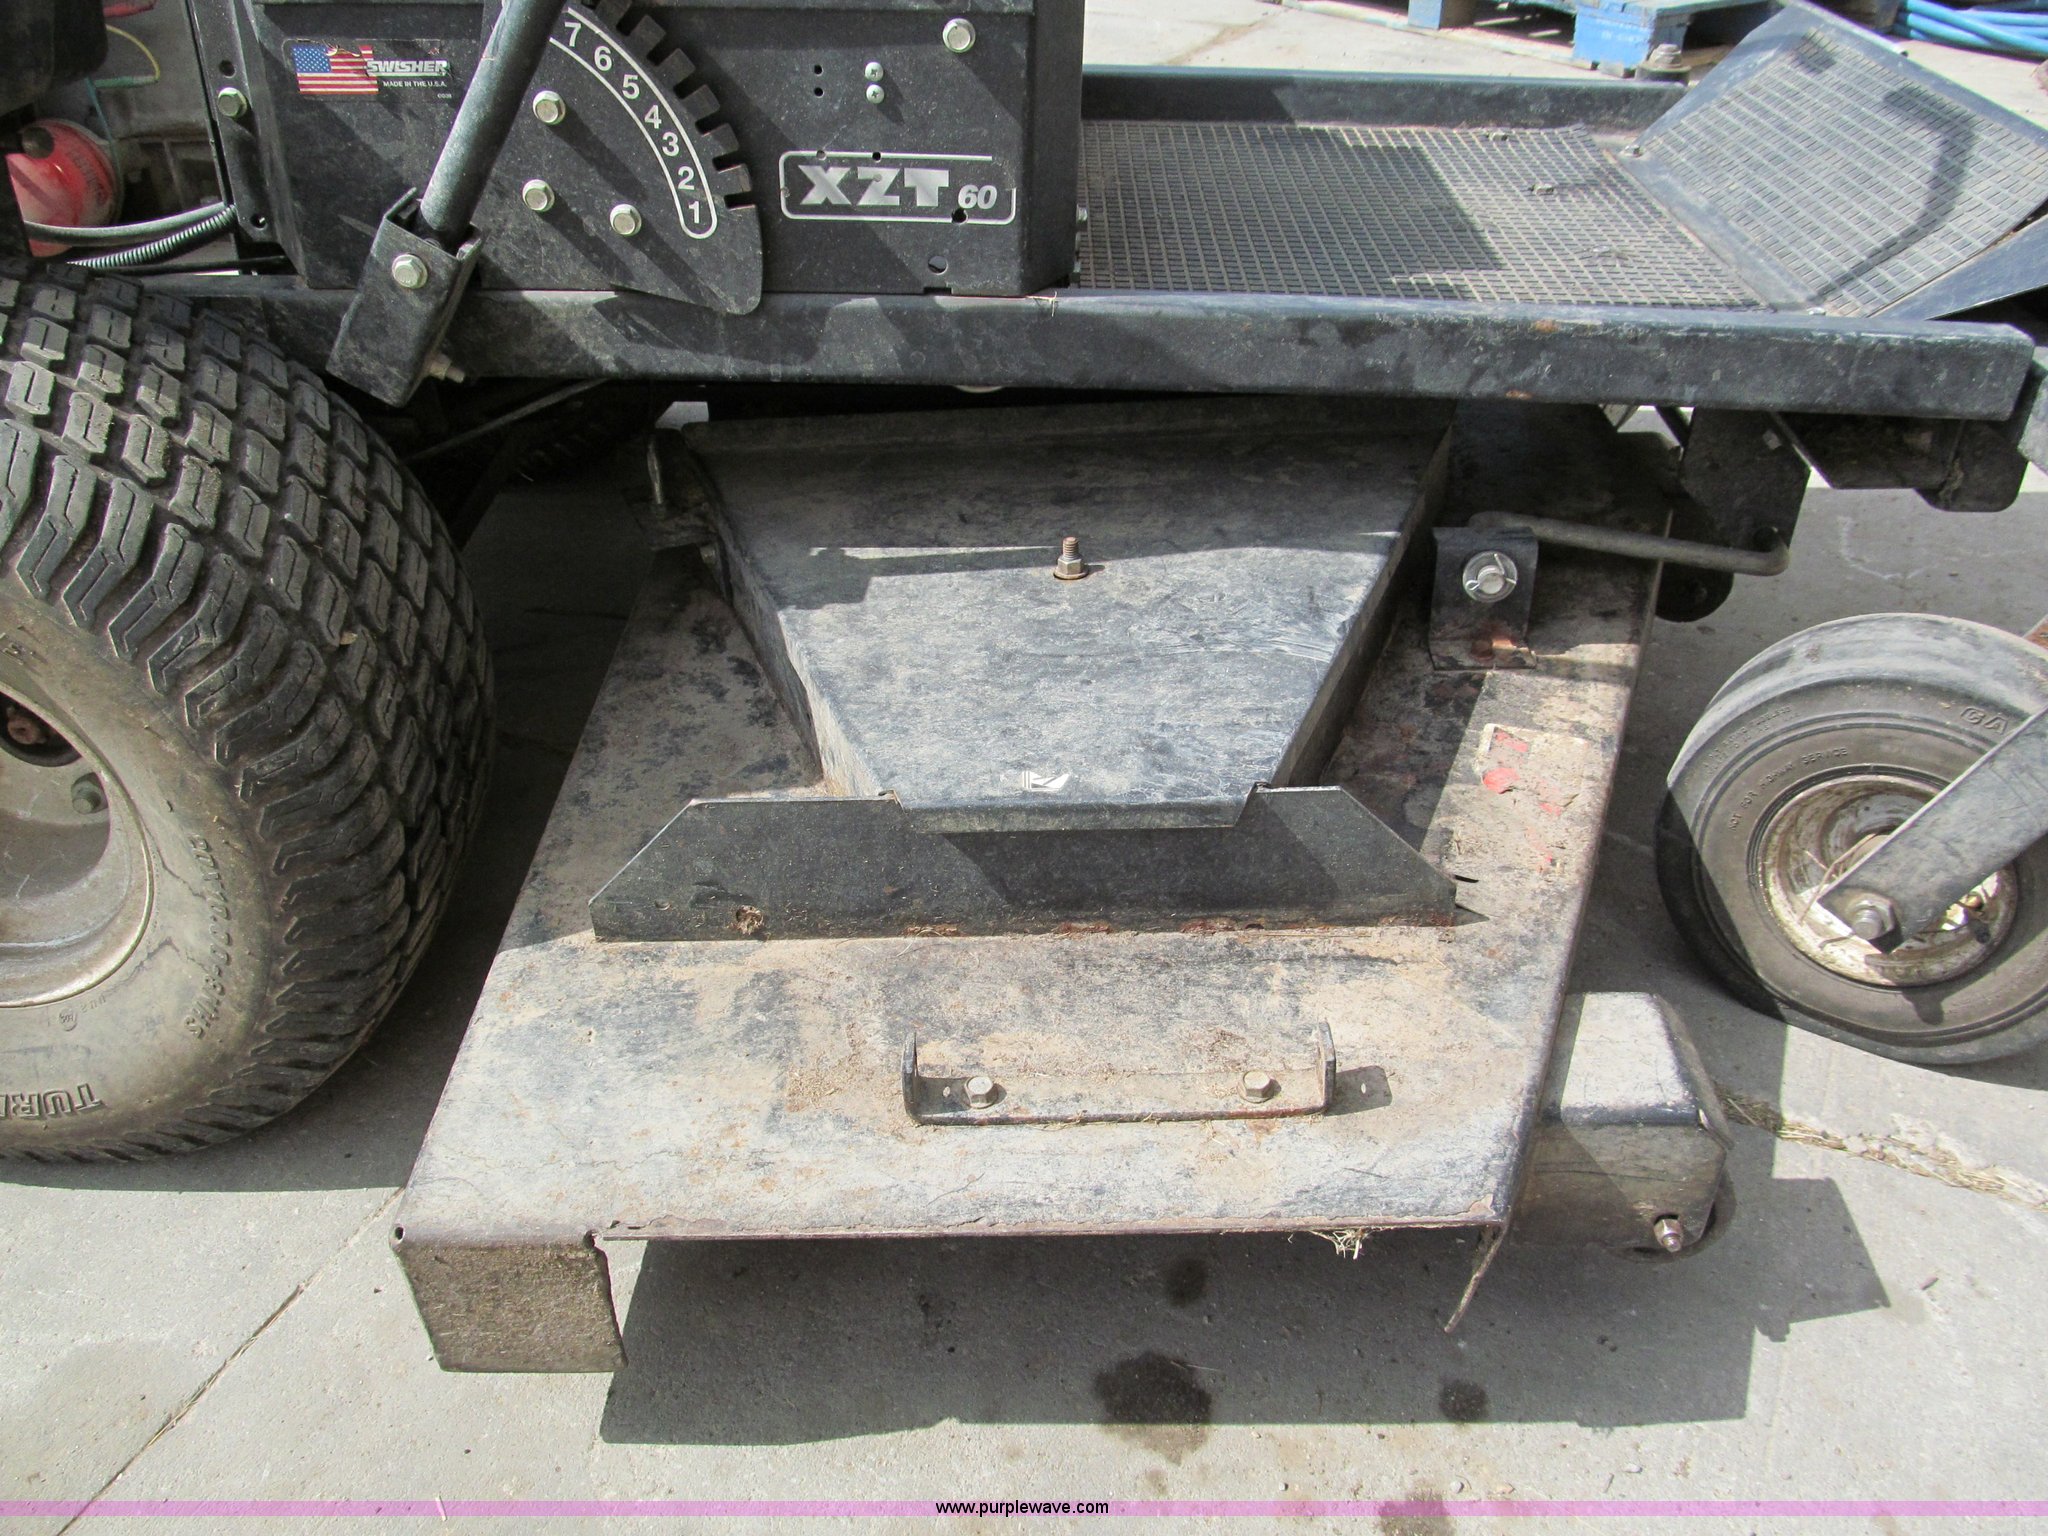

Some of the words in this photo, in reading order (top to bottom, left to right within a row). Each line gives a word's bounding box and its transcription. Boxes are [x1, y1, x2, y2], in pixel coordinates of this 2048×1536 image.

[366, 60, 449, 74] SWISHER
[564, 22, 582, 47] 7
[594, 46, 612, 71] 6
[622, 74, 640, 99] 5
[644, 105, 662, 129] 4
[662, 132, 679, 156] 3
[677, 166, 694, 190] 2
[688, 201, 700, 223] 1
[798, 165, 949, 207] XZT
[957, 184, 997, 209] 60
[1729, 813, 1742, 831] NOT
[1740, 791, 1758, 809] FOR
[1801, 747, 1849, 765] SERVICE
